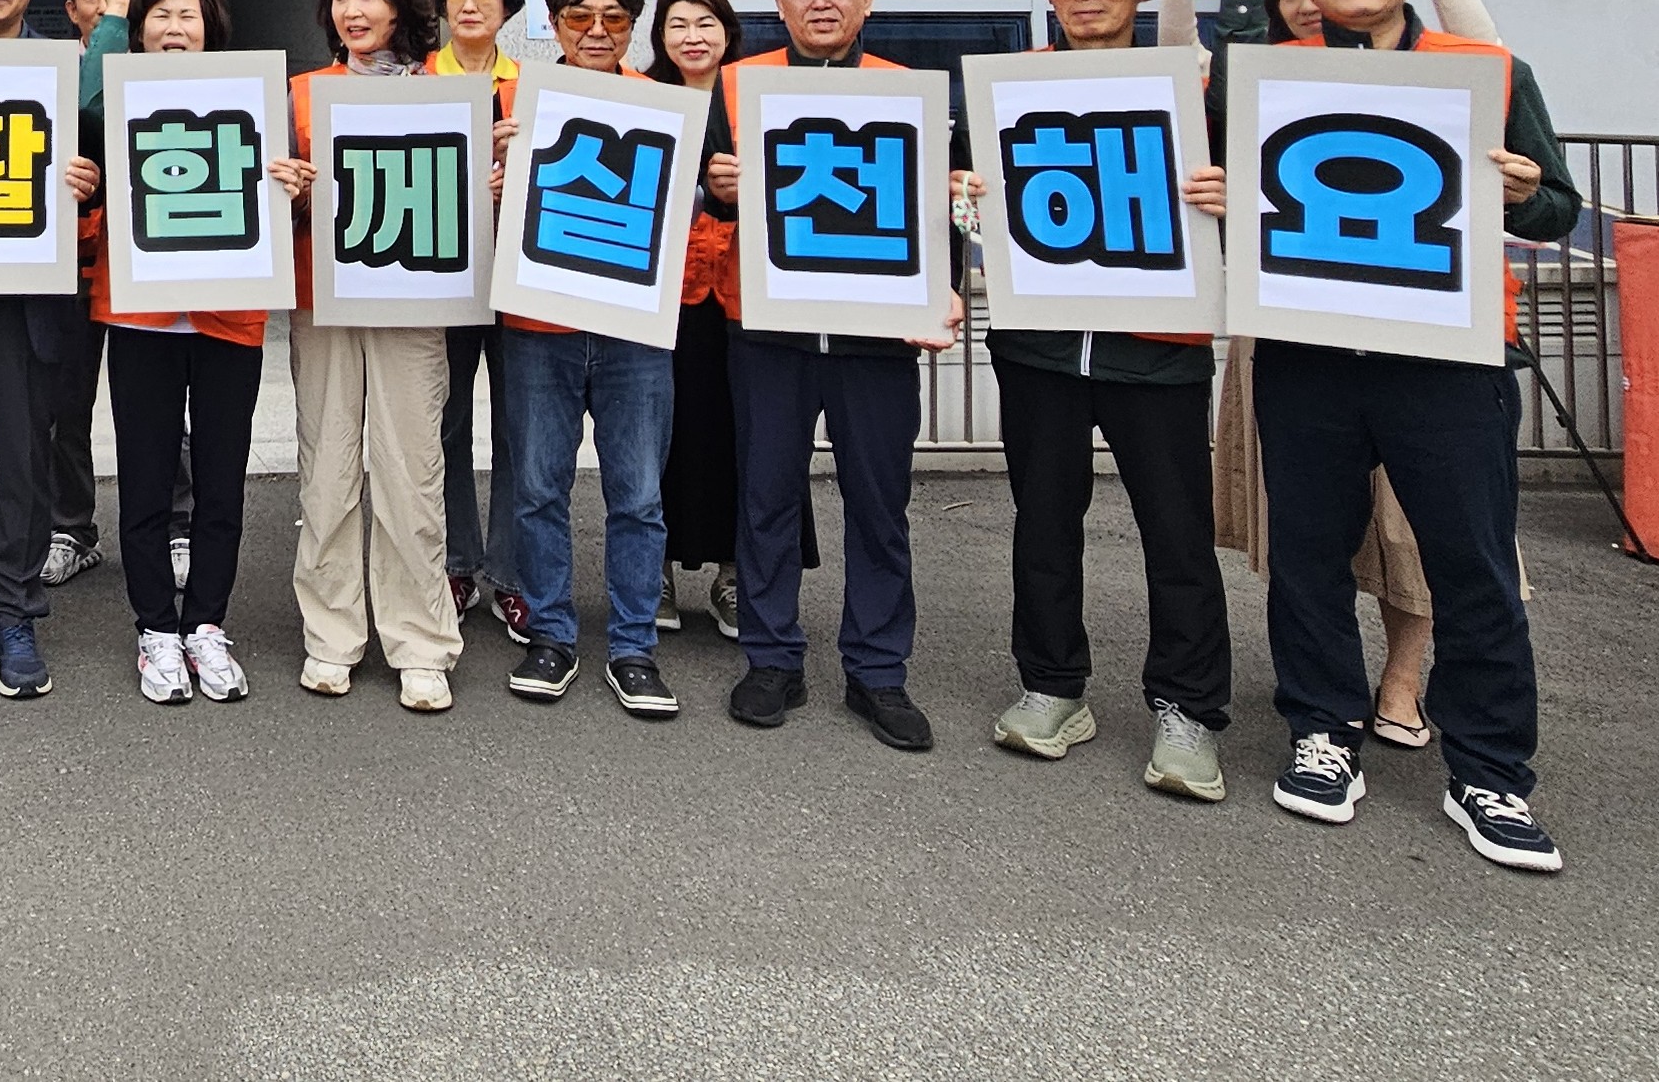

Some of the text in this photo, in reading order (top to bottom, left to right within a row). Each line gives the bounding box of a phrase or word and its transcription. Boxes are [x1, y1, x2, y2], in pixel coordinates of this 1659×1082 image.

[131, 119, 258, 242] 함
[339, 143, 462, 263] 께
[532, 130, 668, 274] 실
[772, 129, 912, 264] 천
[1008, 122, 1178, 258] 해
[1266, 127, 1456, 277] 요
